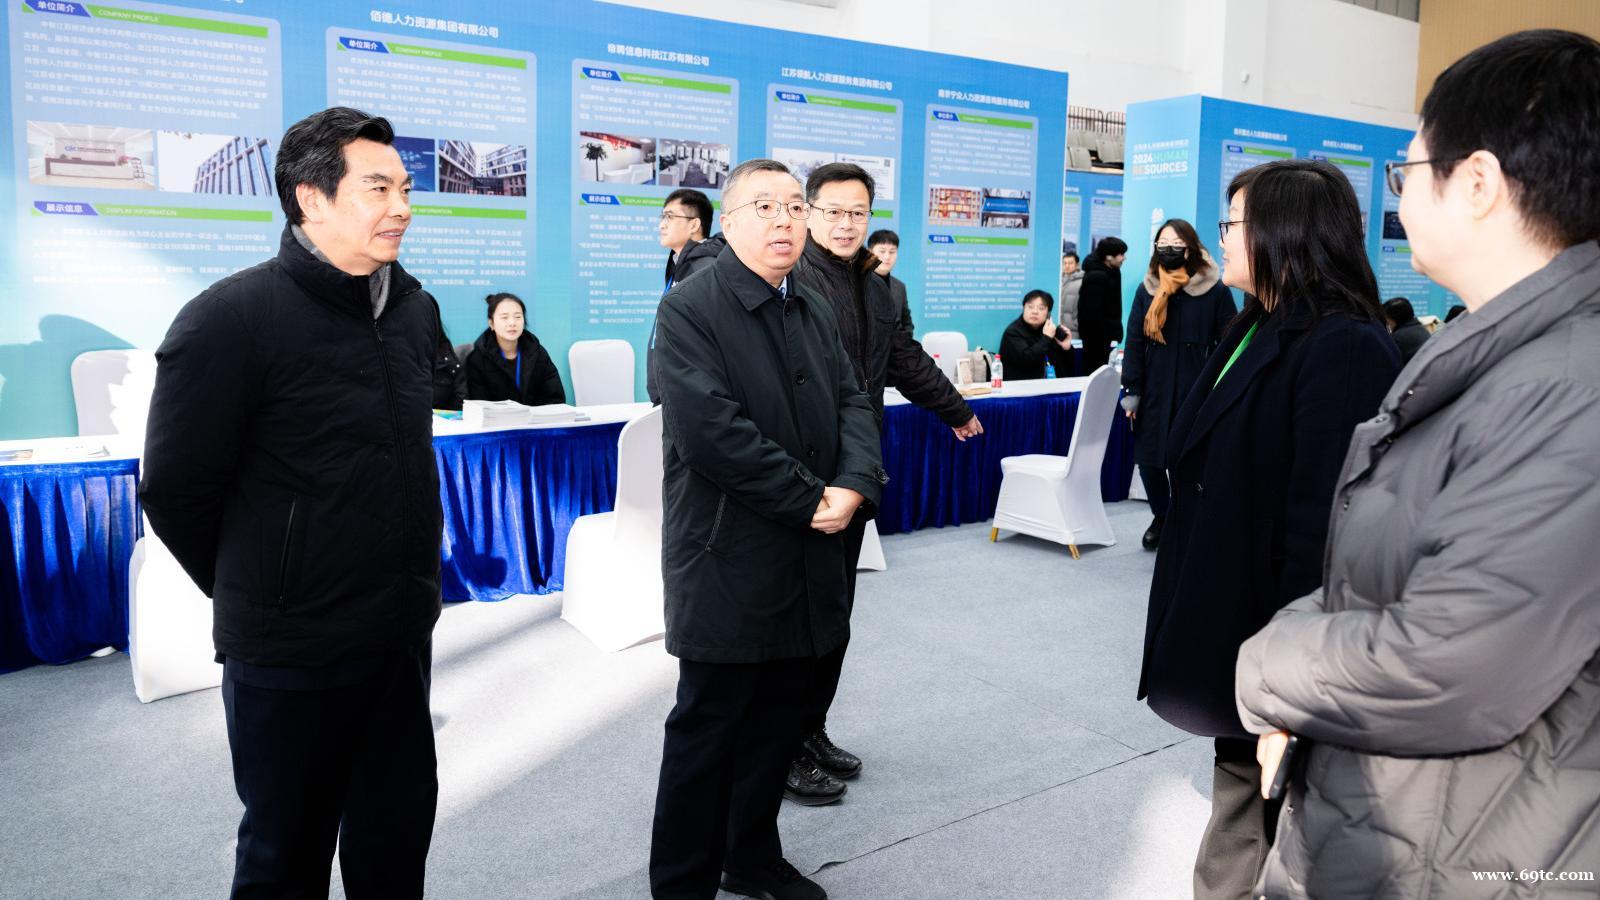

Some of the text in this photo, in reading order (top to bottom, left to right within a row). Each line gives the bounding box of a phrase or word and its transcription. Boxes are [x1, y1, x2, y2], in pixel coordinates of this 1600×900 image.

[37, 1, 75, 13] 单位简介
[98, 9, 159, 22] COMPANY PROFILE
[370, 9, 499, 39] 佰德人力资源集团有限公司
[349, 39, 379, 51] 单位简介
[46, 203, 83, 214] 展示信息
